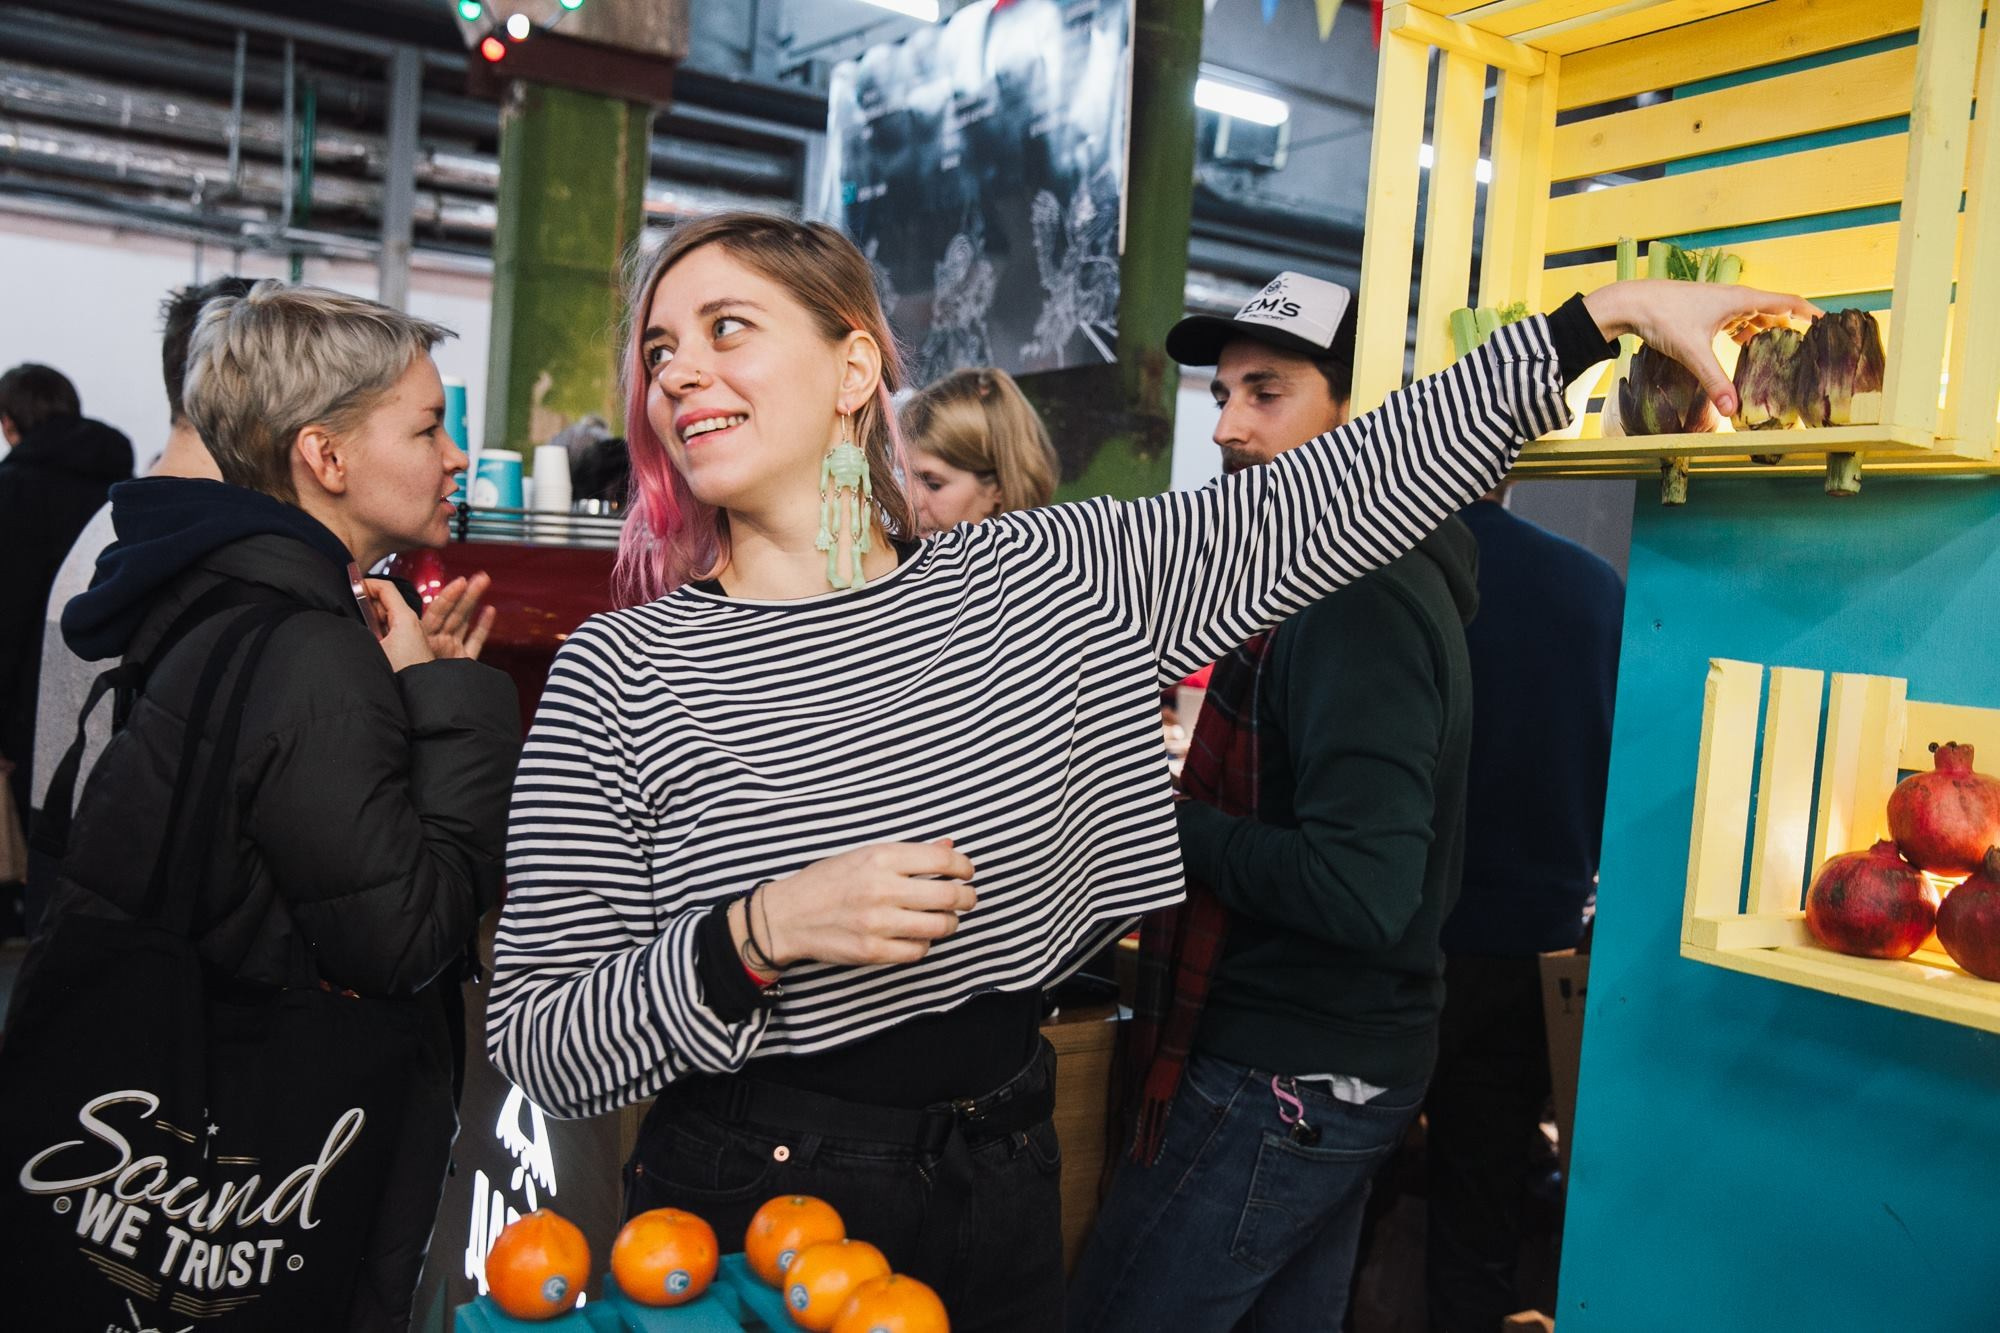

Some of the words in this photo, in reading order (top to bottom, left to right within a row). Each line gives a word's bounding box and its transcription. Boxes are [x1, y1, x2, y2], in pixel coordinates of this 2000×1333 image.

[19, 1089, 365, 1233] Sound
[76, 1187, 150, 1258] WE
[159, 1225, 284, 1290] TRUST
